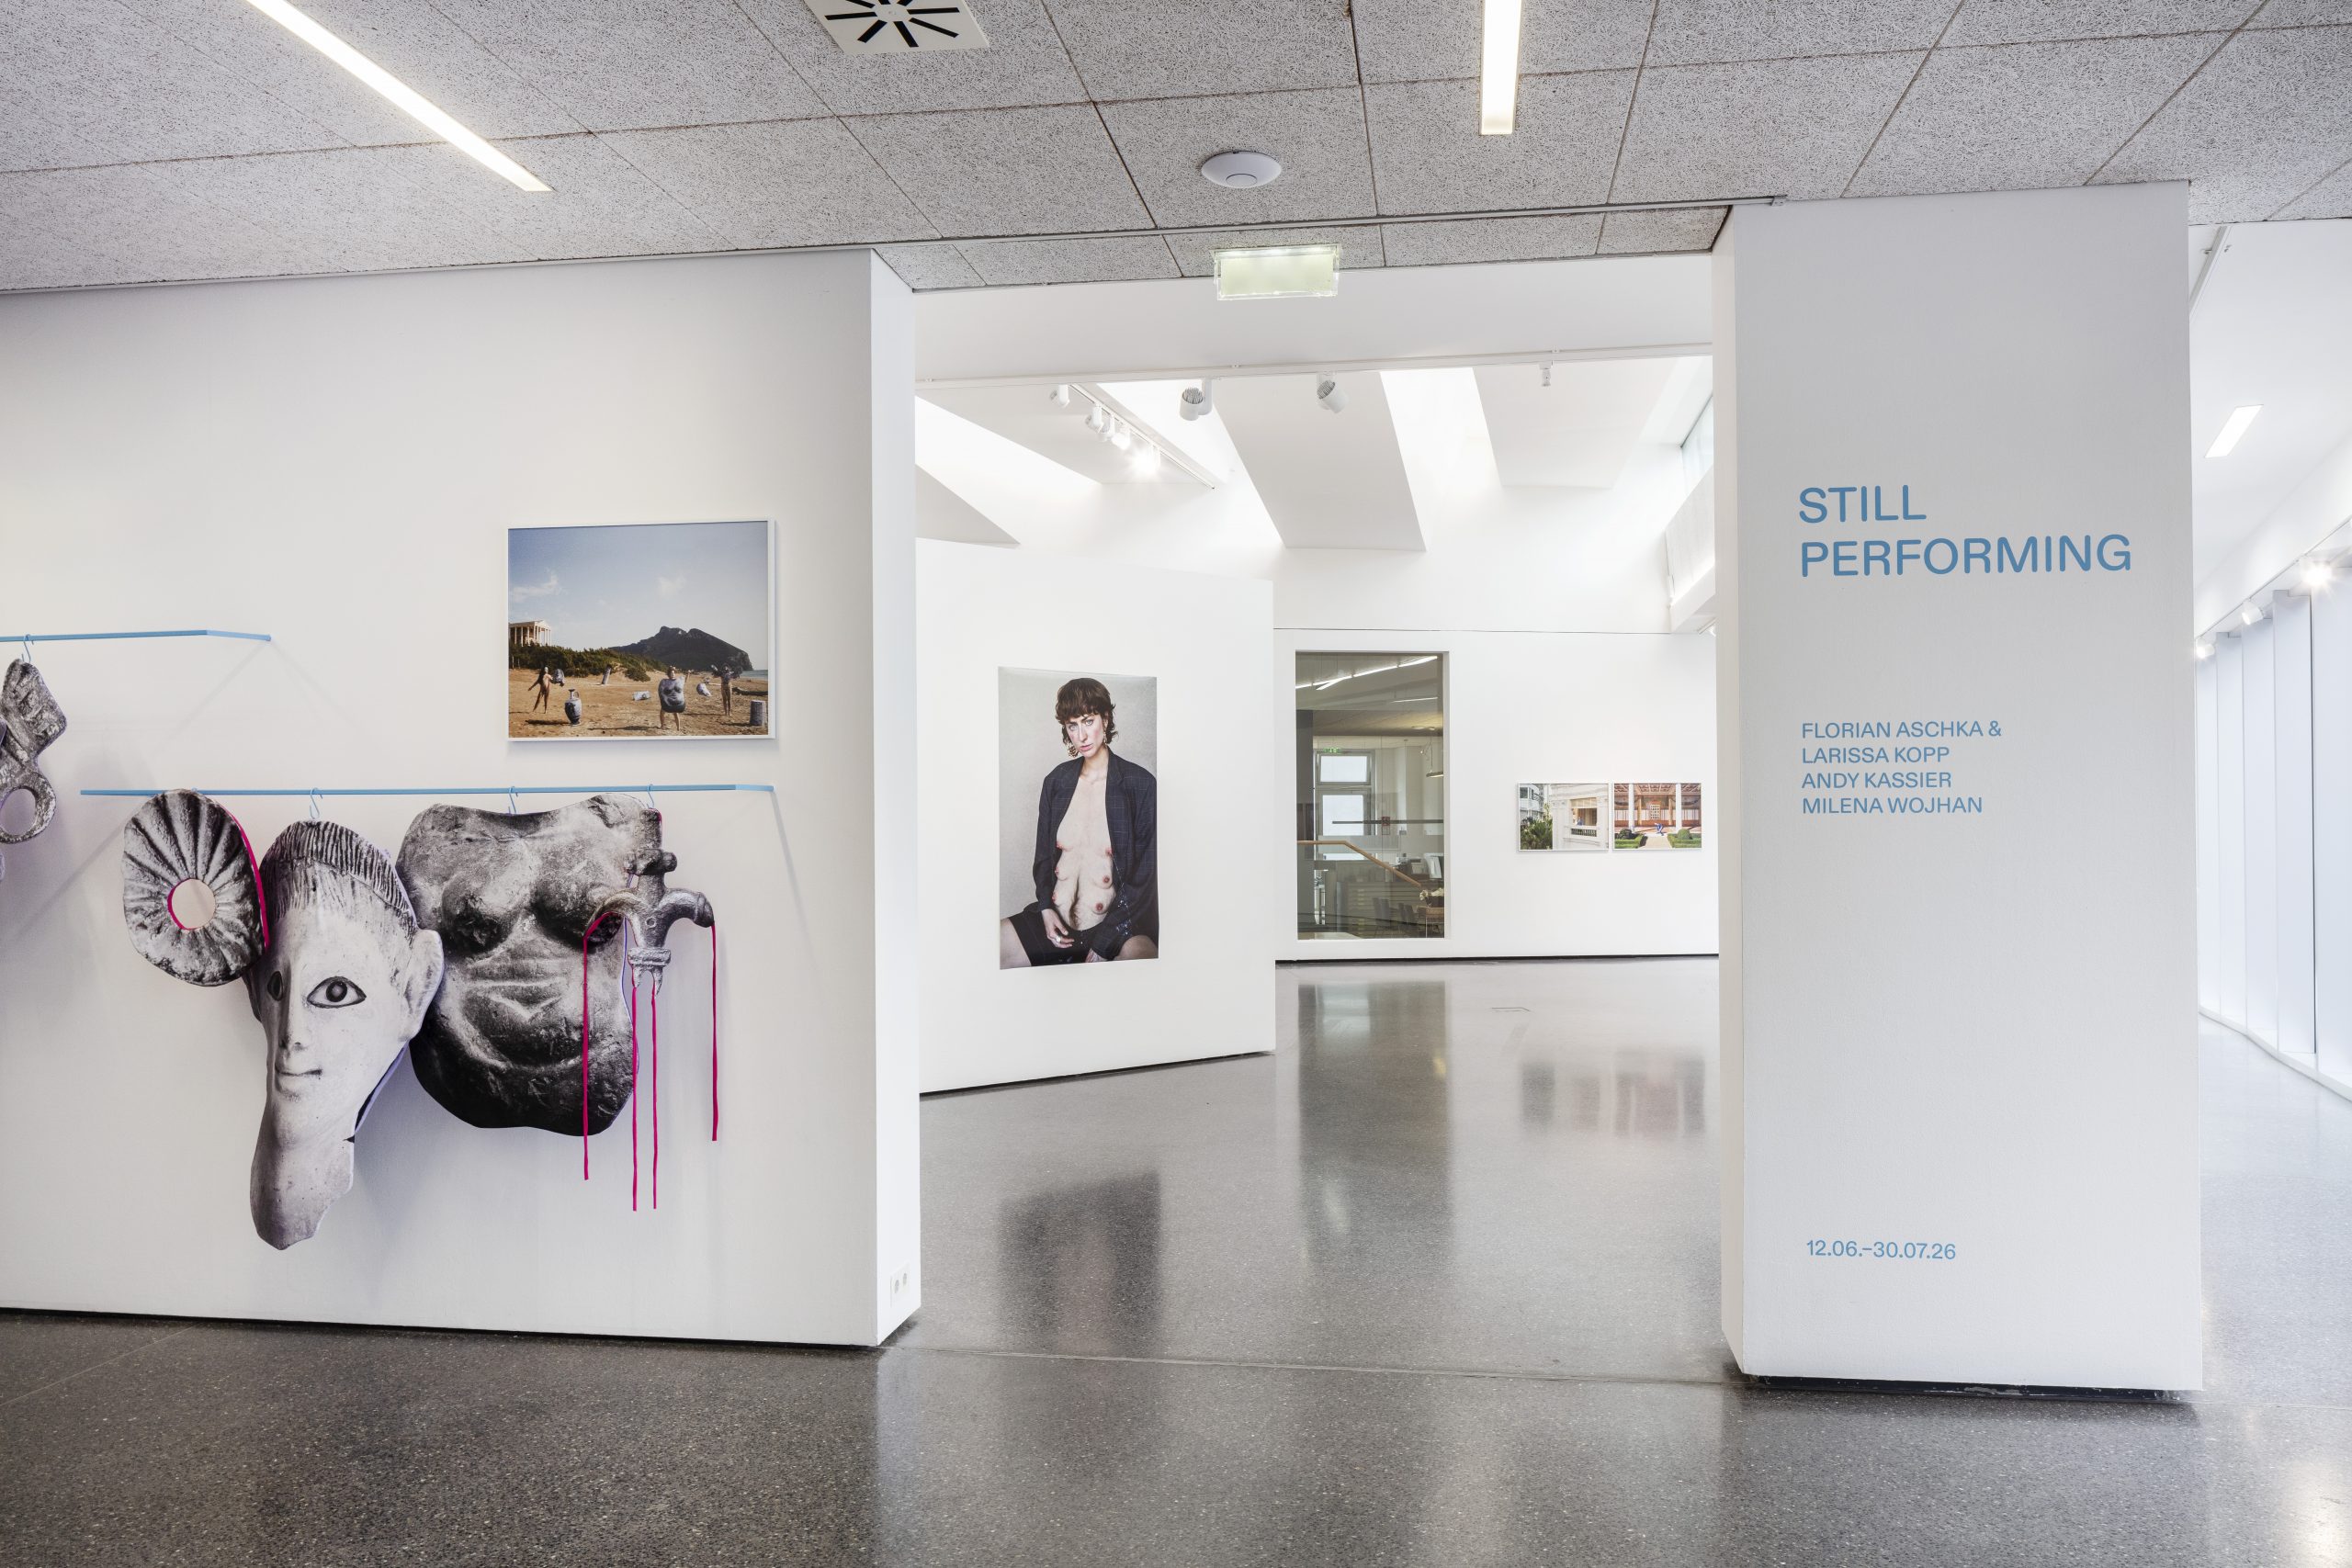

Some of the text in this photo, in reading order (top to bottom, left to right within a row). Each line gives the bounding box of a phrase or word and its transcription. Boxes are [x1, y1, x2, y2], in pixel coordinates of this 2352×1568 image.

[1799, 485, 1927, 524] STILL
[1802, 534, 2132, 578] PERFORMING
[1802, 720, 2002, 739] FLORIAN ASCHKA &
[1802, 746, 1950, 764] LARISSA KOPP
[1802, 772, 1952, 789] ANDY KASSIER
[1803, 796, 1983, 814] MILENA WOJHAN
